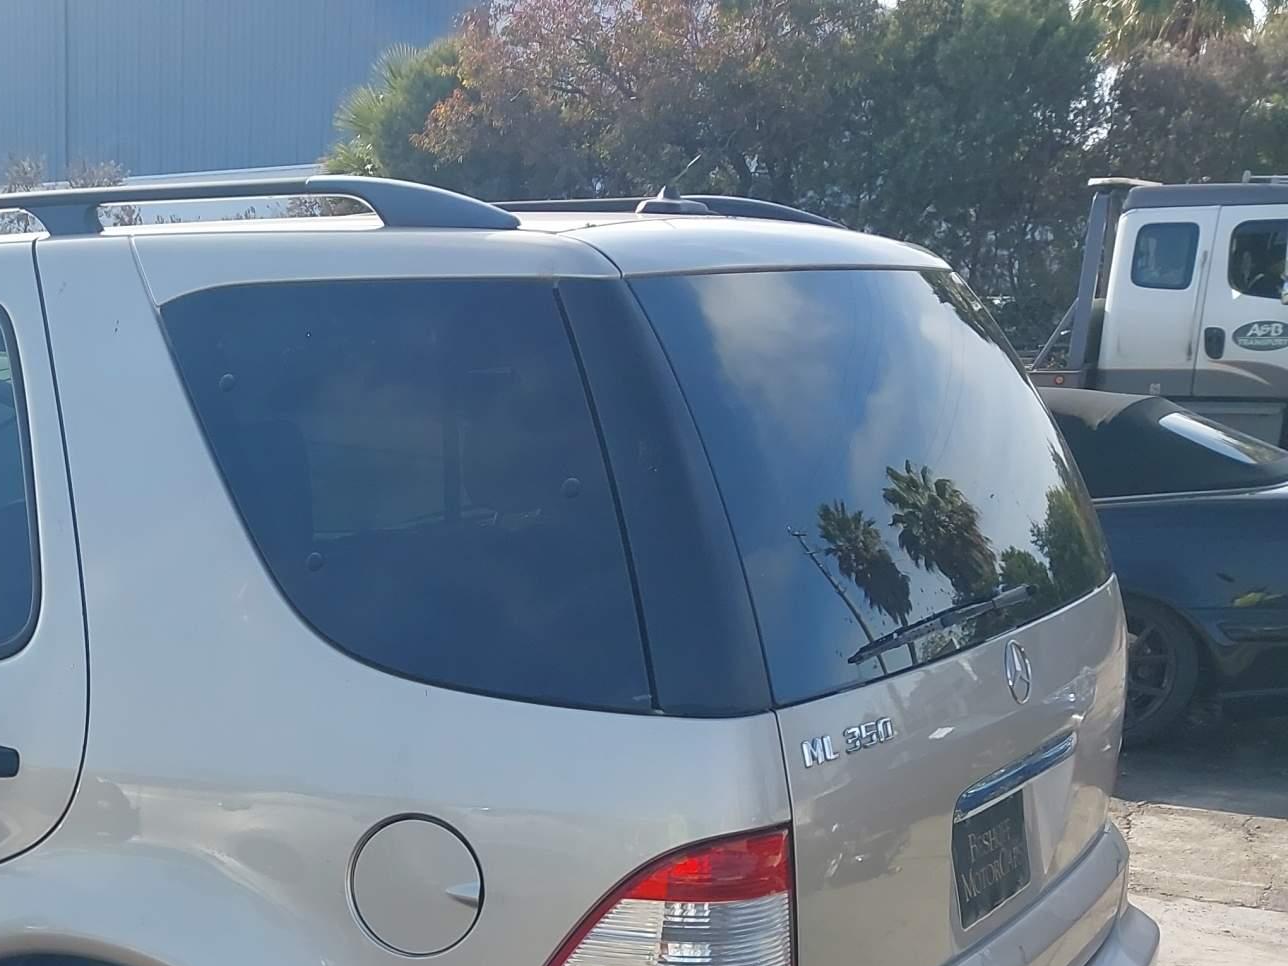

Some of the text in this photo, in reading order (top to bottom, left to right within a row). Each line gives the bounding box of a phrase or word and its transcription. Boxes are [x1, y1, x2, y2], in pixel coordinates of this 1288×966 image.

[1238, 338, 1288, 346] TRAORT
[801, 716, 894, 768] ML 350
